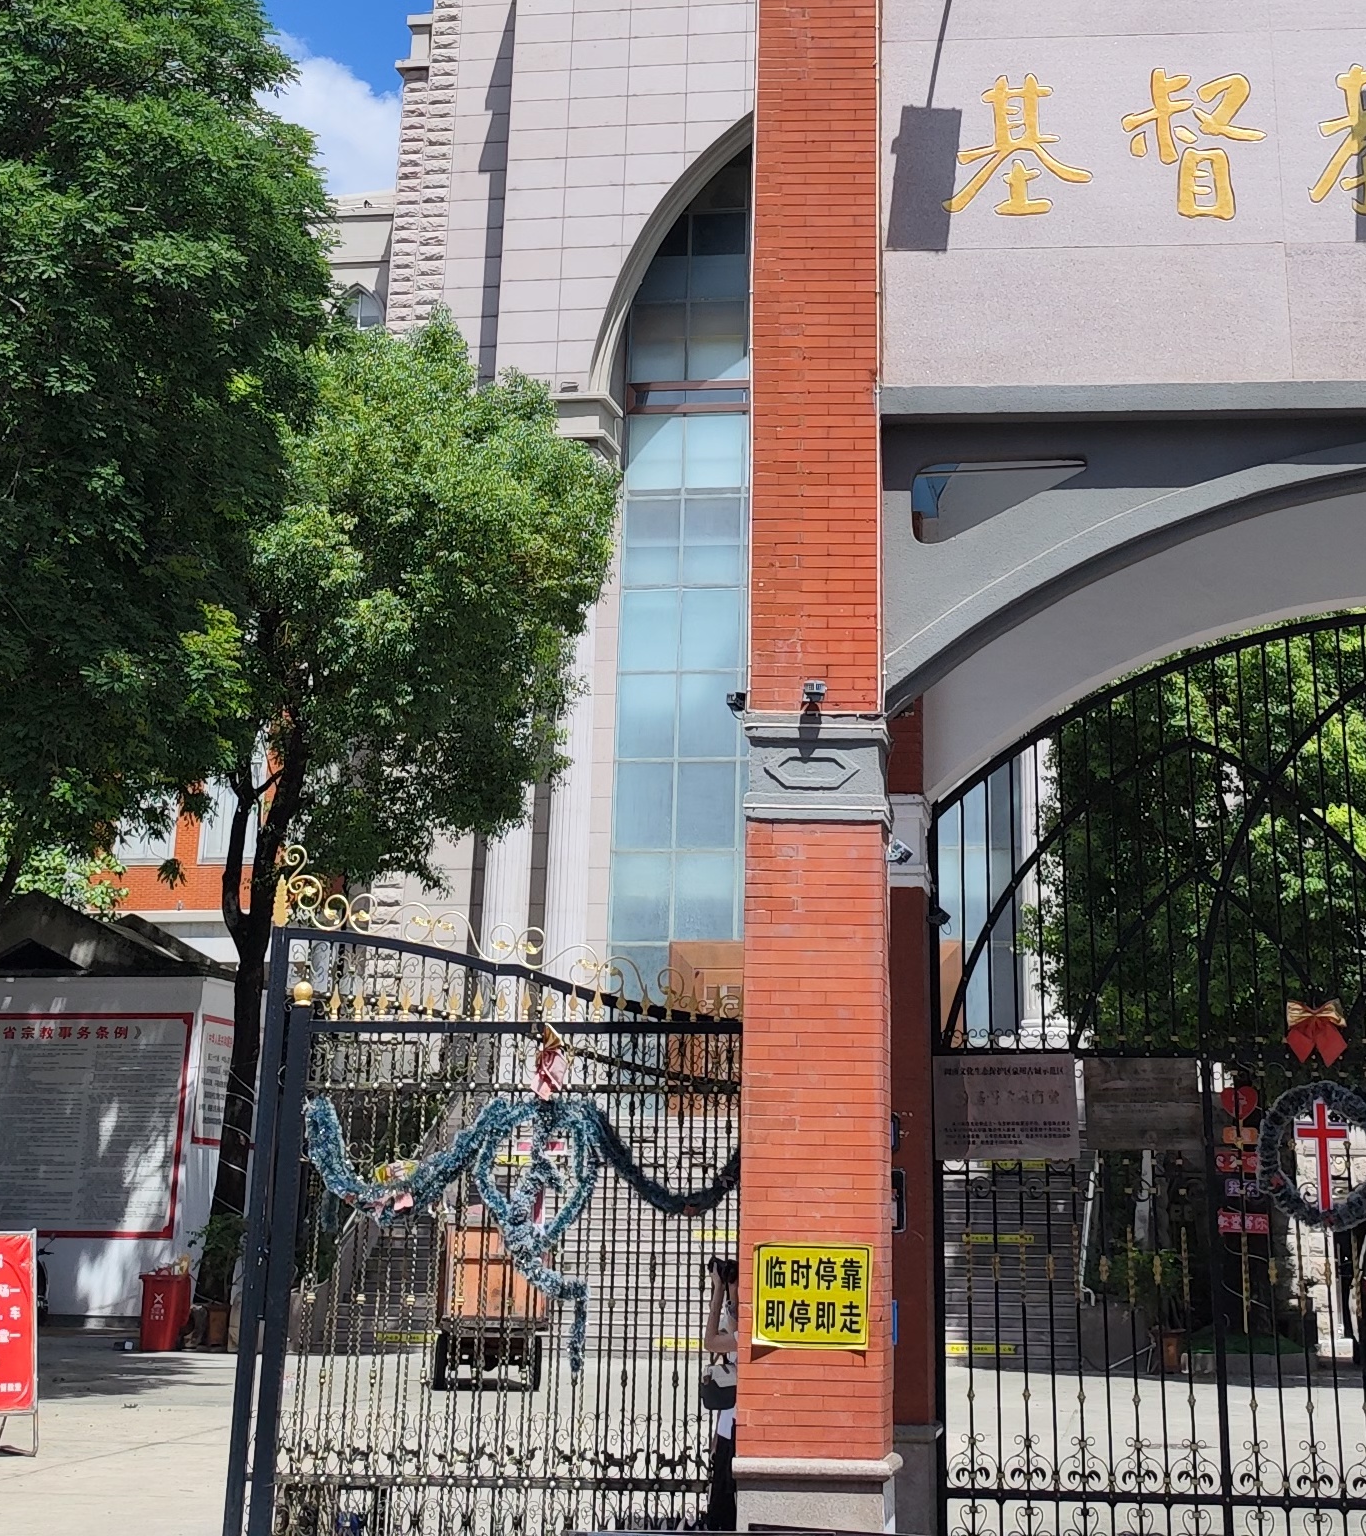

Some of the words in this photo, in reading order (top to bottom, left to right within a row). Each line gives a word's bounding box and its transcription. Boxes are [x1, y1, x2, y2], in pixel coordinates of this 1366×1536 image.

[765, 1257, 863, 1292] 临时停靠
[765, 1300, 863, 1335] 即停即走
